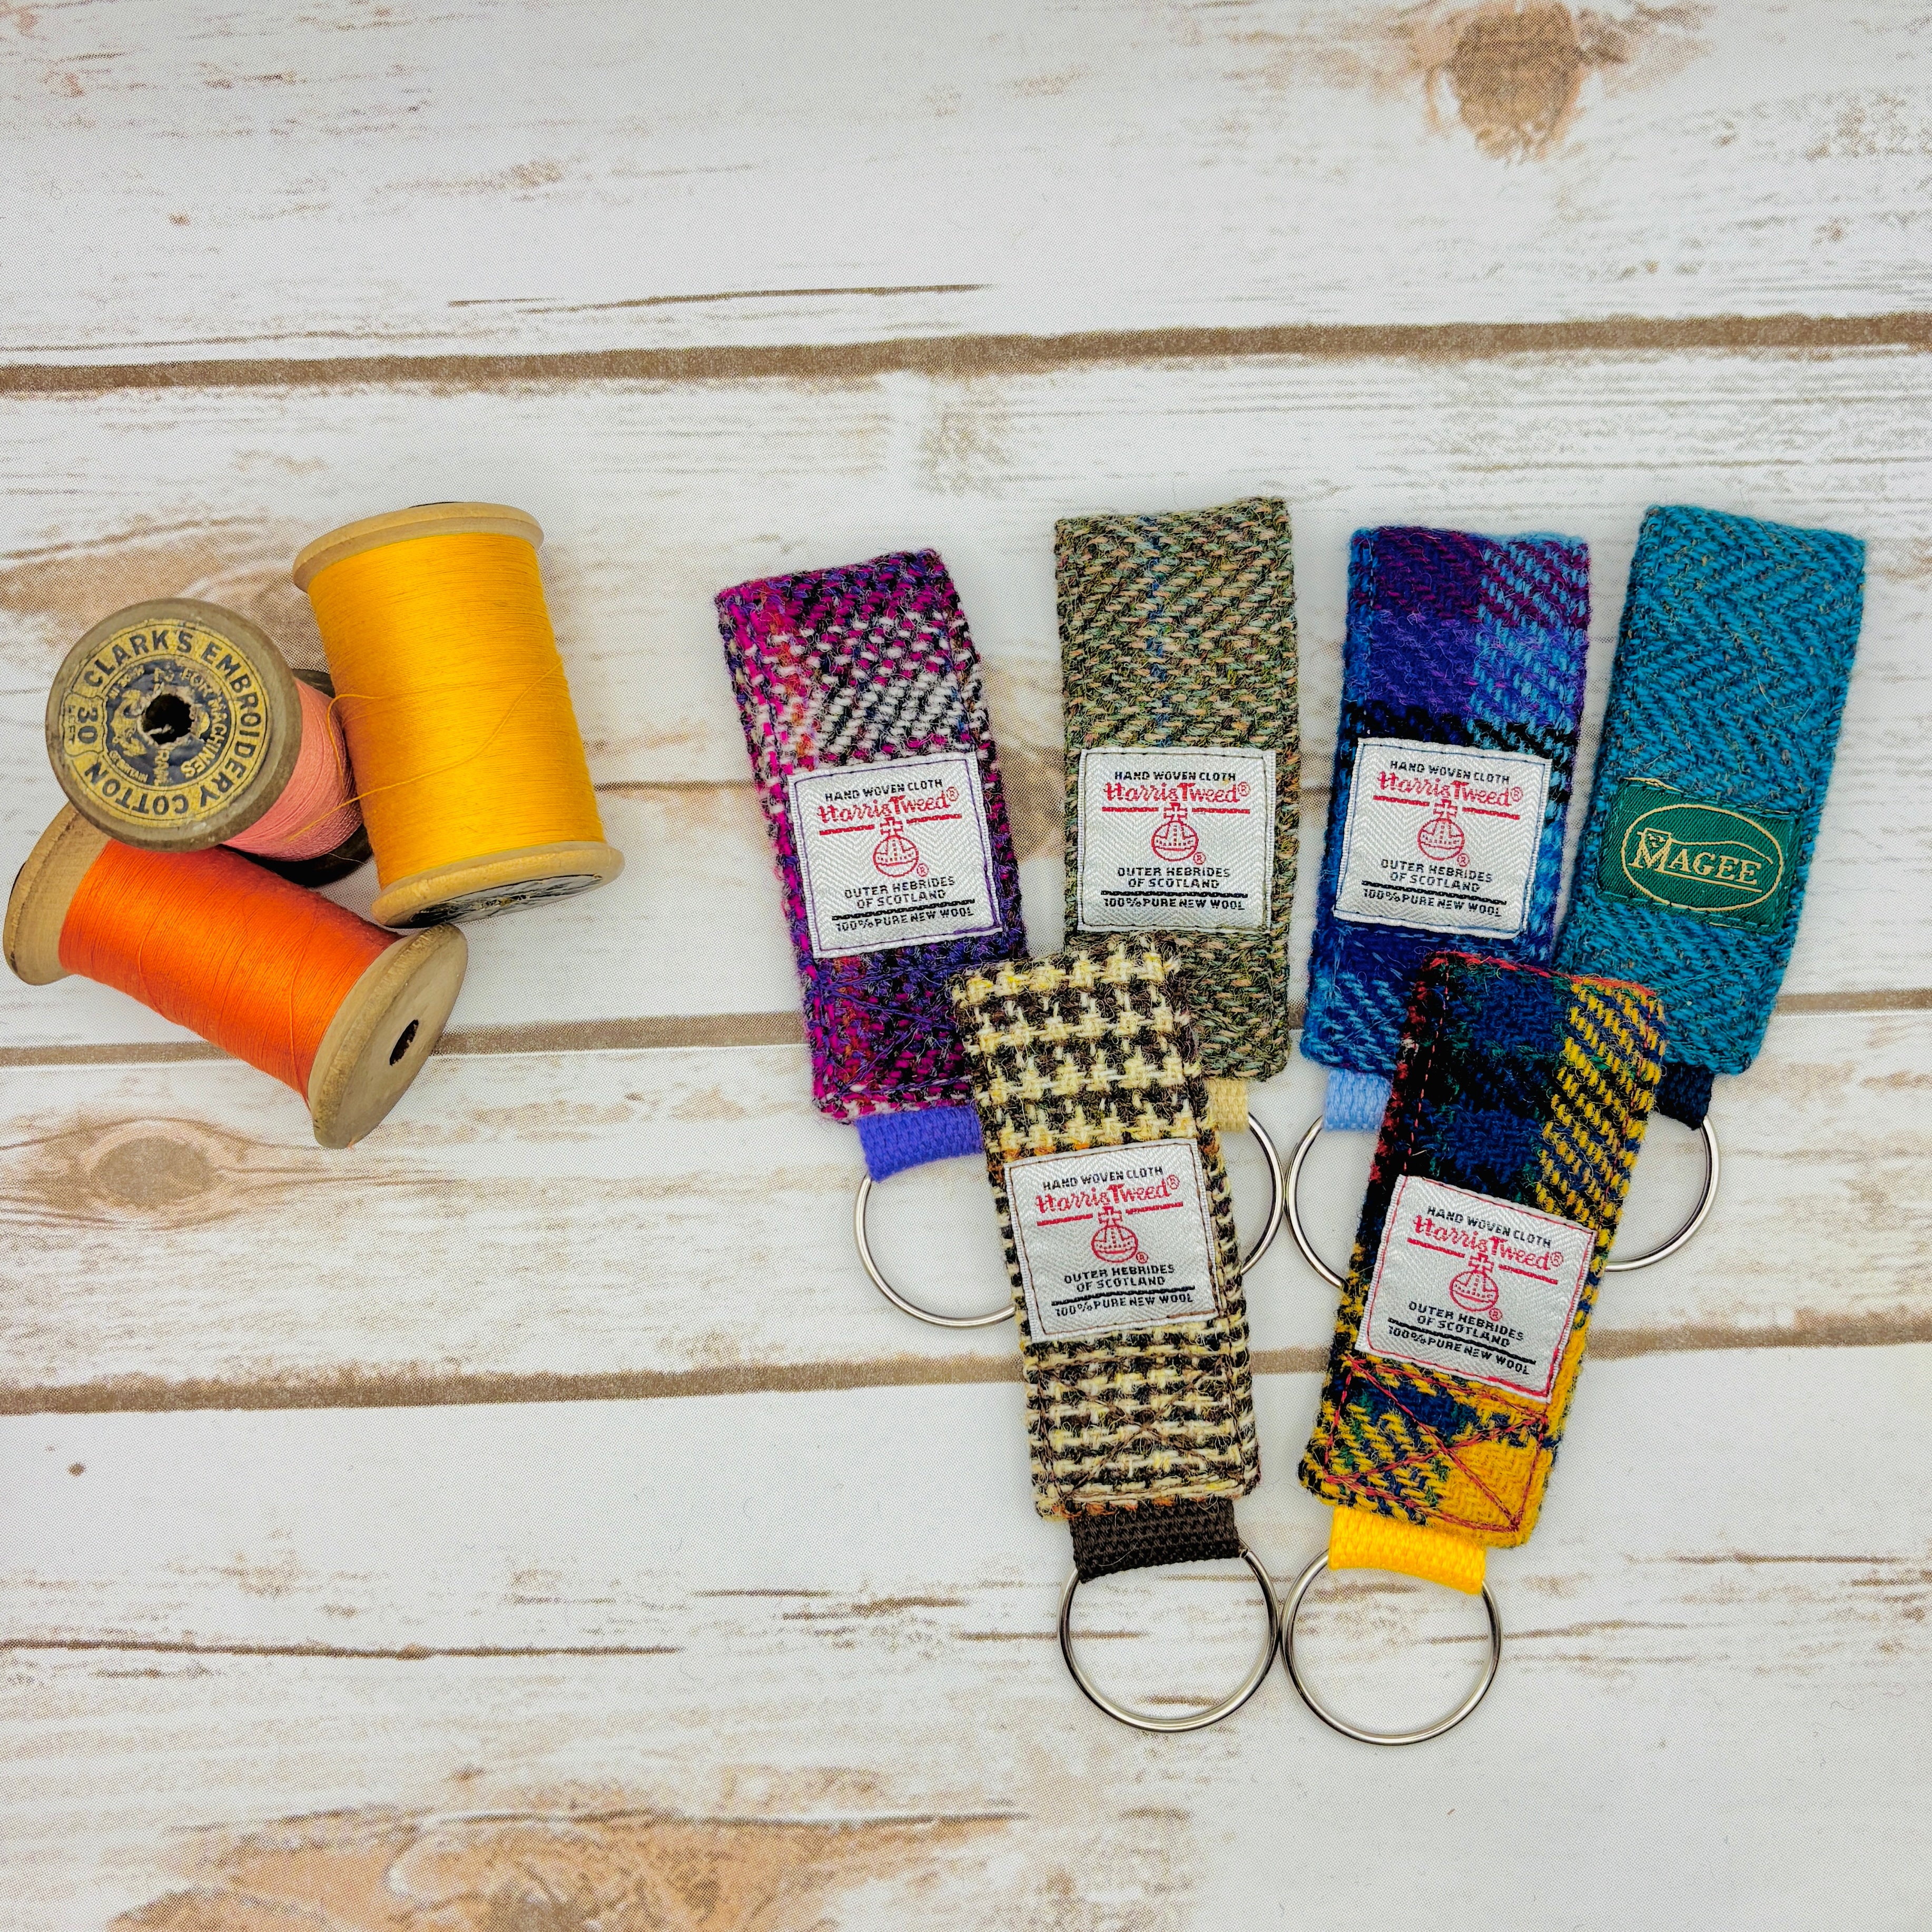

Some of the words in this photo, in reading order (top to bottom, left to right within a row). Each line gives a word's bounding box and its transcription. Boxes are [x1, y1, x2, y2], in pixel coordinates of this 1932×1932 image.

[83, 629, 193, 687] CLARK'S
[77, 706, 98, 744] 30
[200, 641, 262, 807] EMBROIDERY
[181, 697, 228, 778] MACHINES
[1115, 772, 1150, 780] HAND
[1199, 772, 1236, 781] CLOTH
[1390, 761, 1425, 772] HAND
[1428, 765, 1471, 779] WOVEN
[1474, 772, 1510, 784] CLOTH
[85, 760, 190, 815] COTTON
[825, 790, 859, 801] HAND
[863, 784, 905, 797] WOVEN
[908, 779, 942, 792] CLOTH
[1629, 830, 1761, 885] MAGEE
[1118, 868, 1161, 876] OUTER
[1166, 868, 1230, 877] HEBRIDES
[1381, 859, 1424, 873] OUTER
[1428, 865, 1492, 883] HEBRIDES
[1390, 872, 1405, 881] OF
[1410, 874, 1480, 892] SCOTLAND
[844, 885, 888, 899] OUTER
[893, 876, 955, 892] HEBRIDES
[1129, 879, 1145, 888] OF
[1149, 879, 1219, 889] SCOTLAND
[857, 899, 873, 909] OF
[878, 890, 945, 906] SCOTLAND
[1144, 898, 1176, 907] PURE
[1179, 899, 1205, 908] NEW
[1210, 900, 1245, 910] WOOL
[1402, 895, 1434, 906] PURE
[1437, 900, 1464, 910] NEW
[1468, 903, 1502, 917] WOOL
[875, 915, 907, 926] PURE
[910, 911, 935, 922] NEW
[940, 907, 974, 918] WOOL
[1043, 1177, 1078, 1190] HAND
[1081, 1171, 1123, 1184] WOVEN
[1126, 1167, 1162, 1179] CLOTH
[1427, 1206, 1464, 1223] HAND
[1467, 1216, 1511, 1237] WOVEN
[1513, 1230, 1551, 1248] CLOTH
[1064, 1270, 1107, 1284] OUTER
[1112, 1264, 1175, 1276] HEBRIDES
[1077, 1283, 1091, 1292] OF
[1097, 1276, 1165, 1289] SCOTLAND
[1094, 1298, 1126, 1309] PURE
[1129, 1296, 1155, 1306] NEW
[1159, 1294, 1193, 1304] WOOL
[1409, 1301, 1454, 1320] OUTER
[1458, 1313, 1524, 1341] HEBRIDES
[1417, 1315, 1435, 1325] OF
[1437, 1320, 1510, 1347] SCOTLAND
[1428, 1337, 1461, 1353] PURE
[1464, 1346, 1493, 1359] NEW
[1495, 1354, 1530, 1375] WOOL
